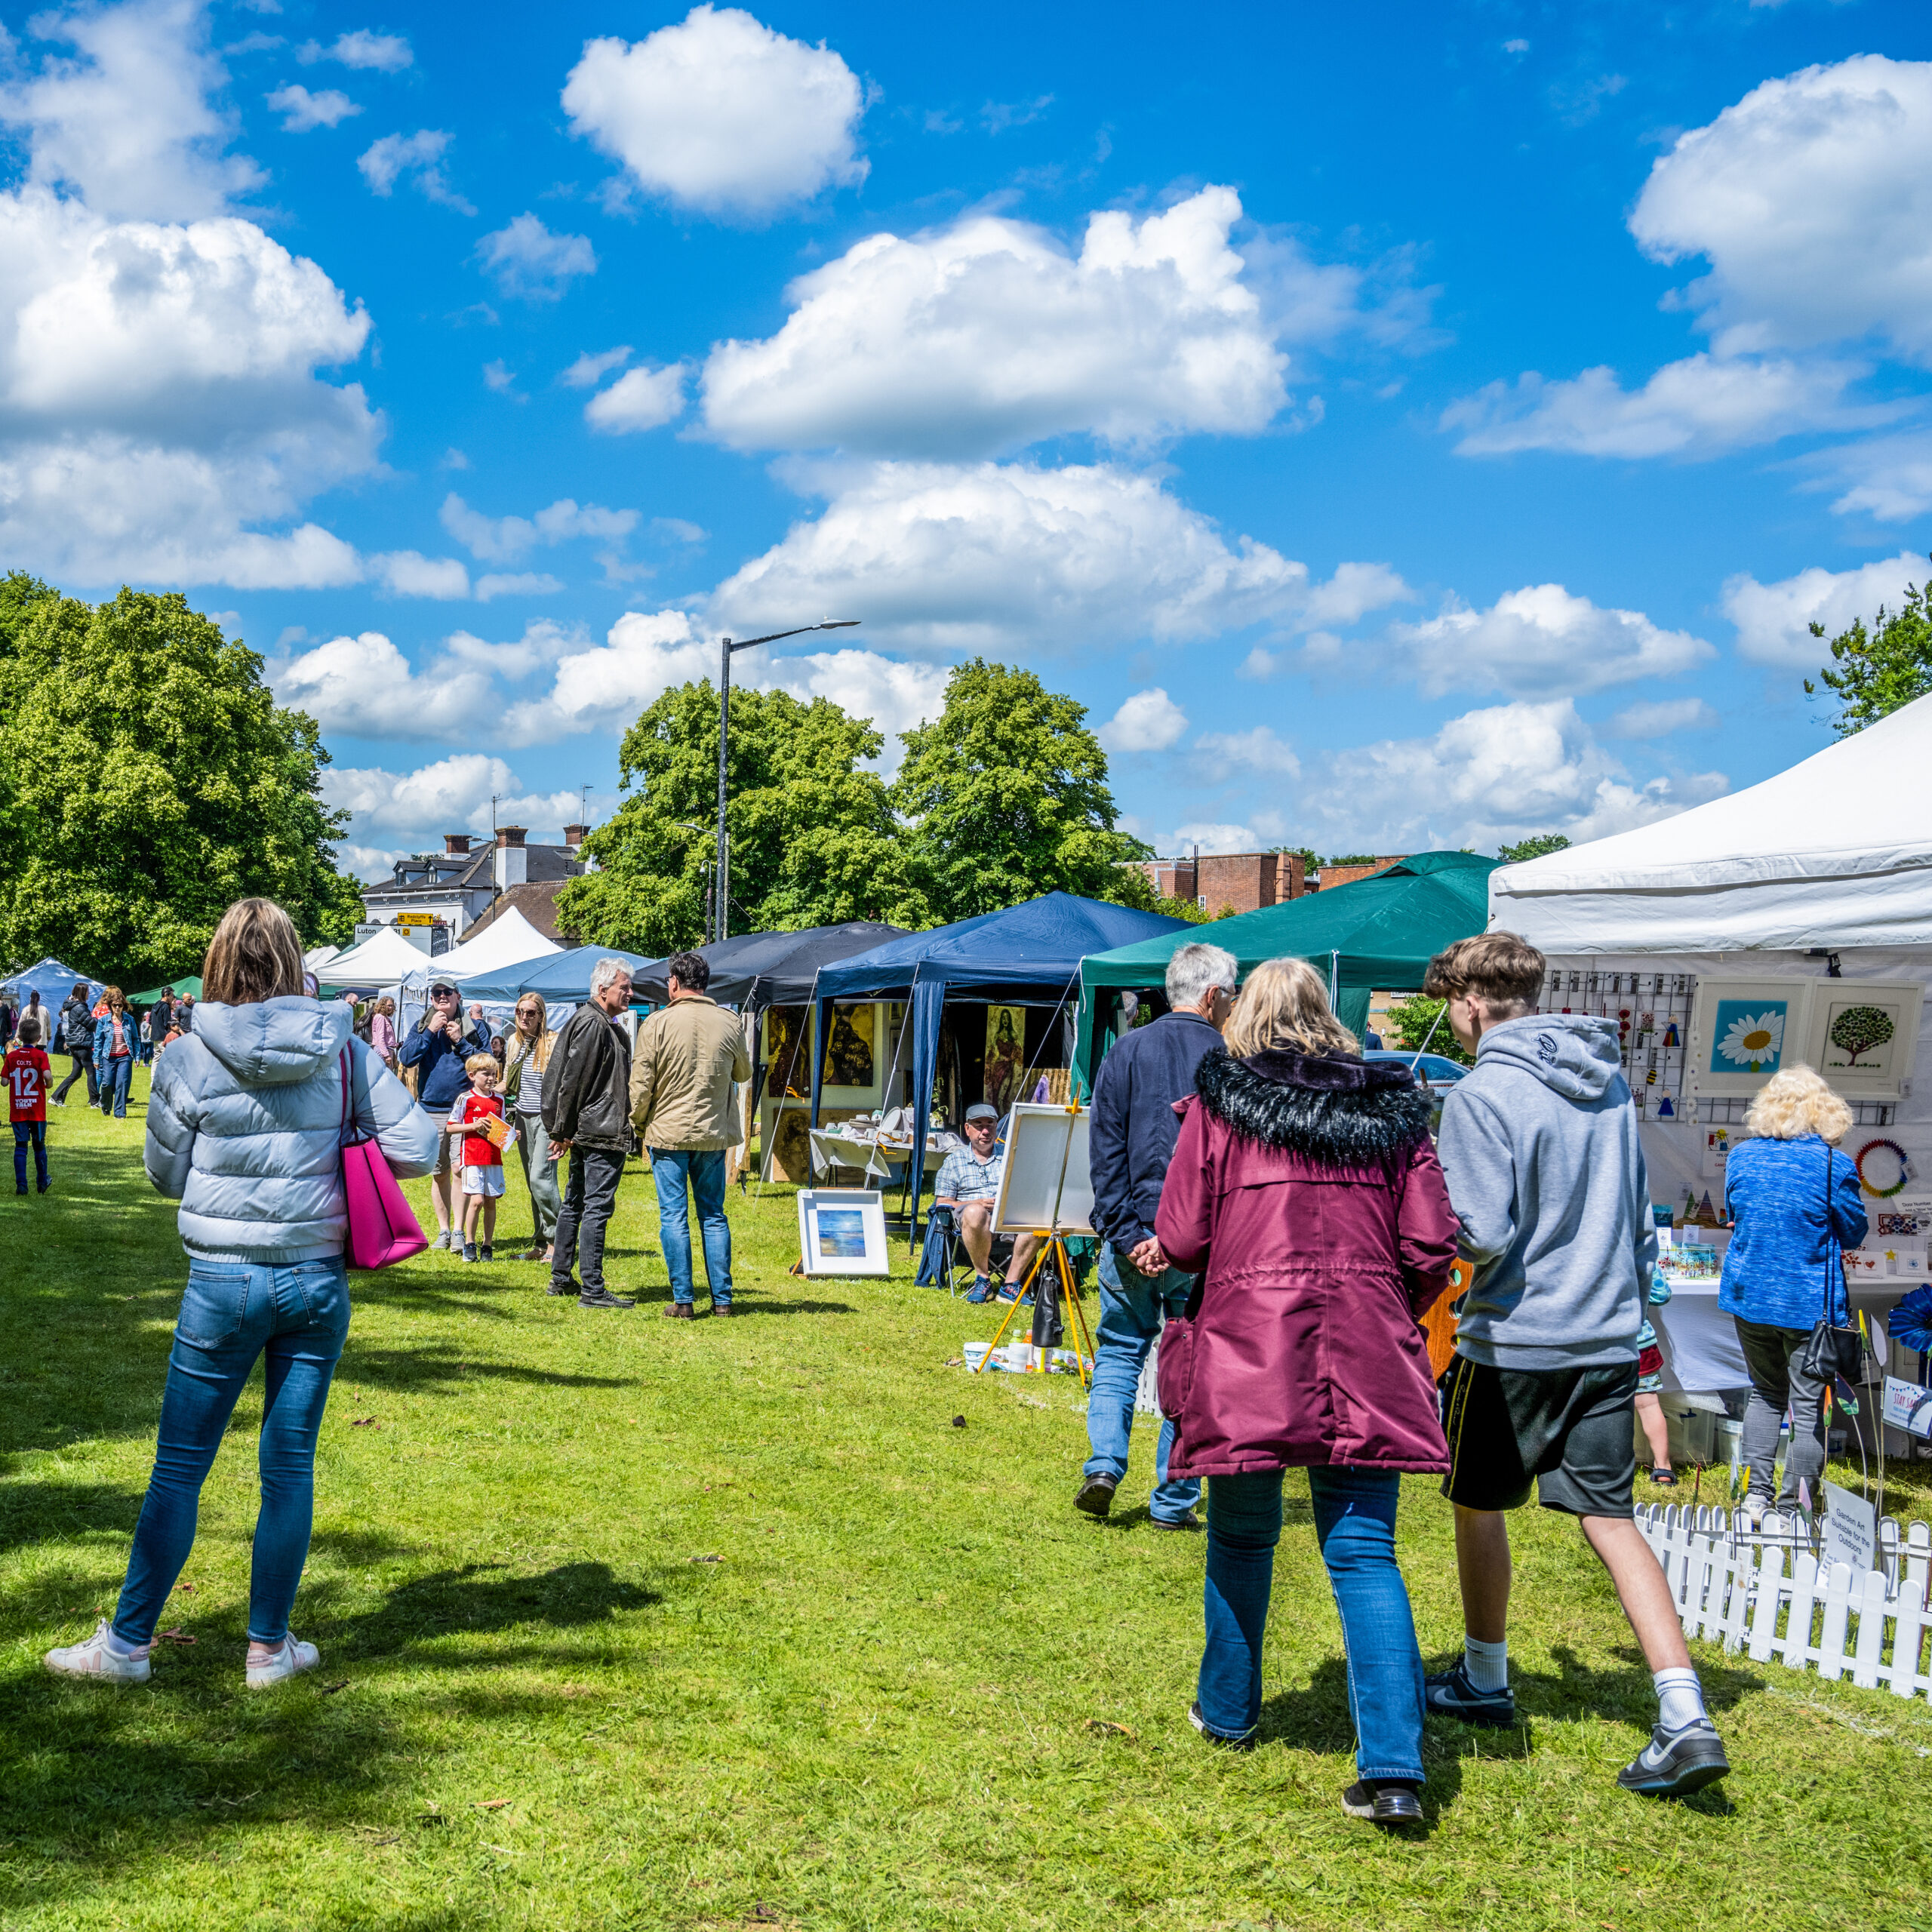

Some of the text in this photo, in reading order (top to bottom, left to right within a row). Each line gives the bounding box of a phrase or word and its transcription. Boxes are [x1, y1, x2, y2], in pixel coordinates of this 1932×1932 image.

[10, 1067, 39, 1096] 12
[1894, 1393, 1906, 1407] STAY
[1836, 1509, 1856, 1526] Garden
[1832, 1518, 1852, 1537] Suitable
[1861, 1537, 1870, 1548] the
[1838, 1534, 1862, 1555] Outdoors
